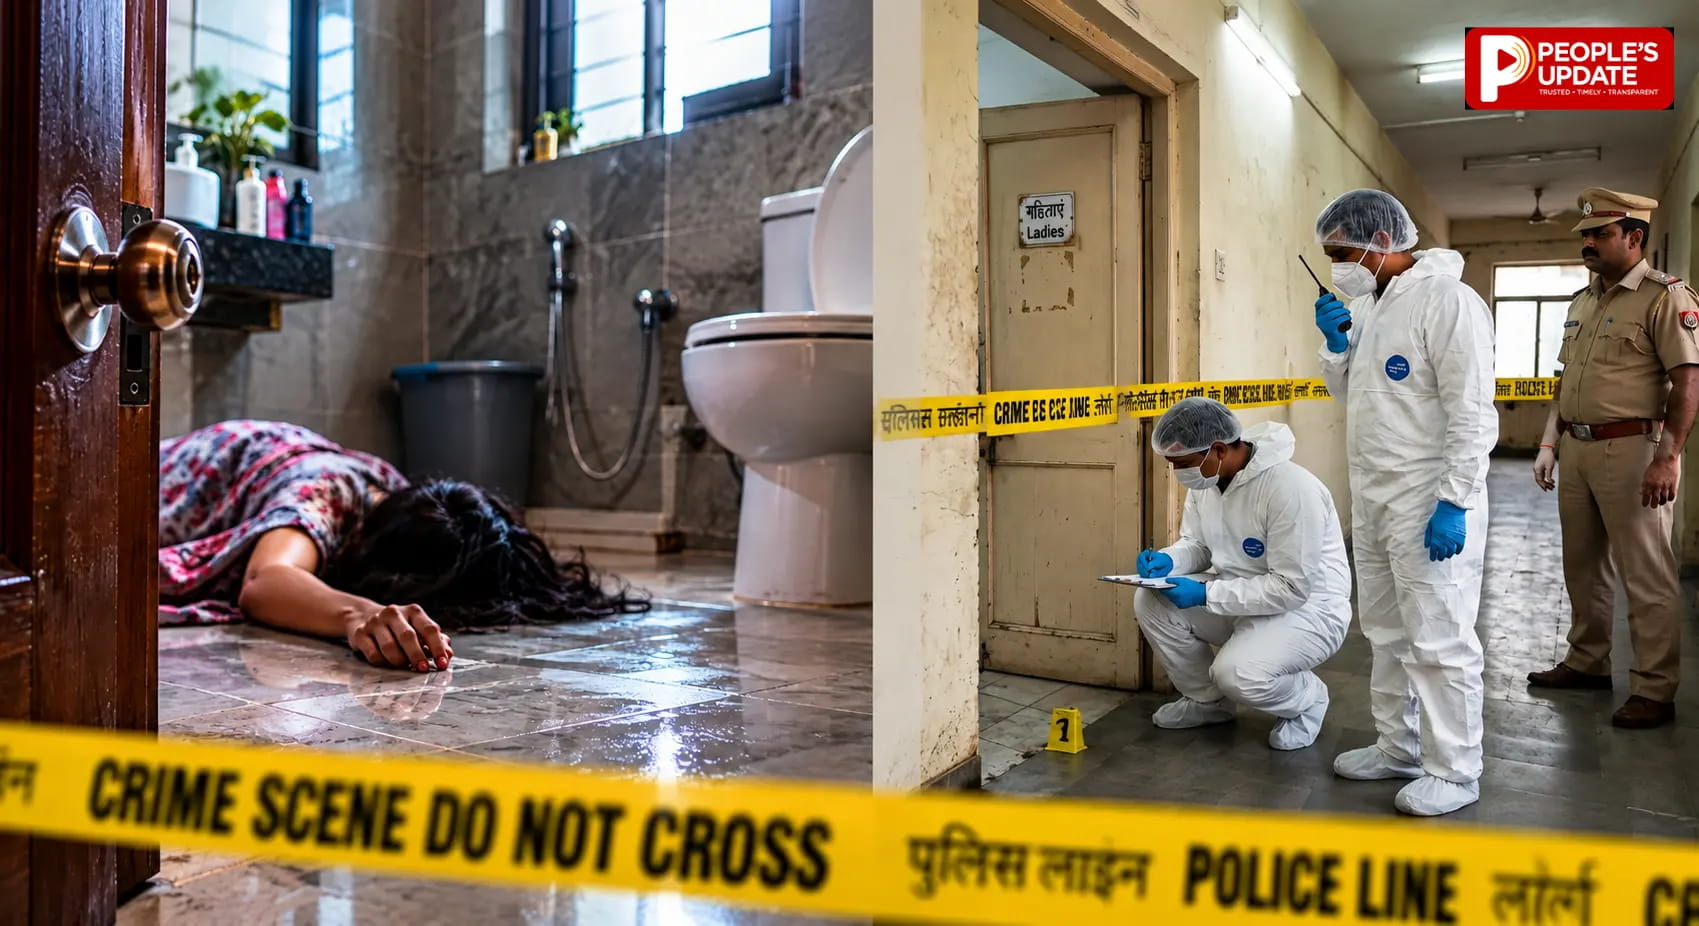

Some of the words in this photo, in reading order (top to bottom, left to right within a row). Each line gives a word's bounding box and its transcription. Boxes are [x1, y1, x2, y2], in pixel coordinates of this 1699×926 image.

[1026, 223, 1065, 240] Ladies
[1055, 717, 1070, 743] 1
[87, 757, 241, 836] CRIME
[251, 771, 411, 854] SCENE
[423, 786, 498, 863] DO
[511, 794, 626, 875] NOT
[639, 803, 833, 893] CROSS
[1182, 841, 1343, 917] POLICE
[1355, 855, 1460, 926] LINE
